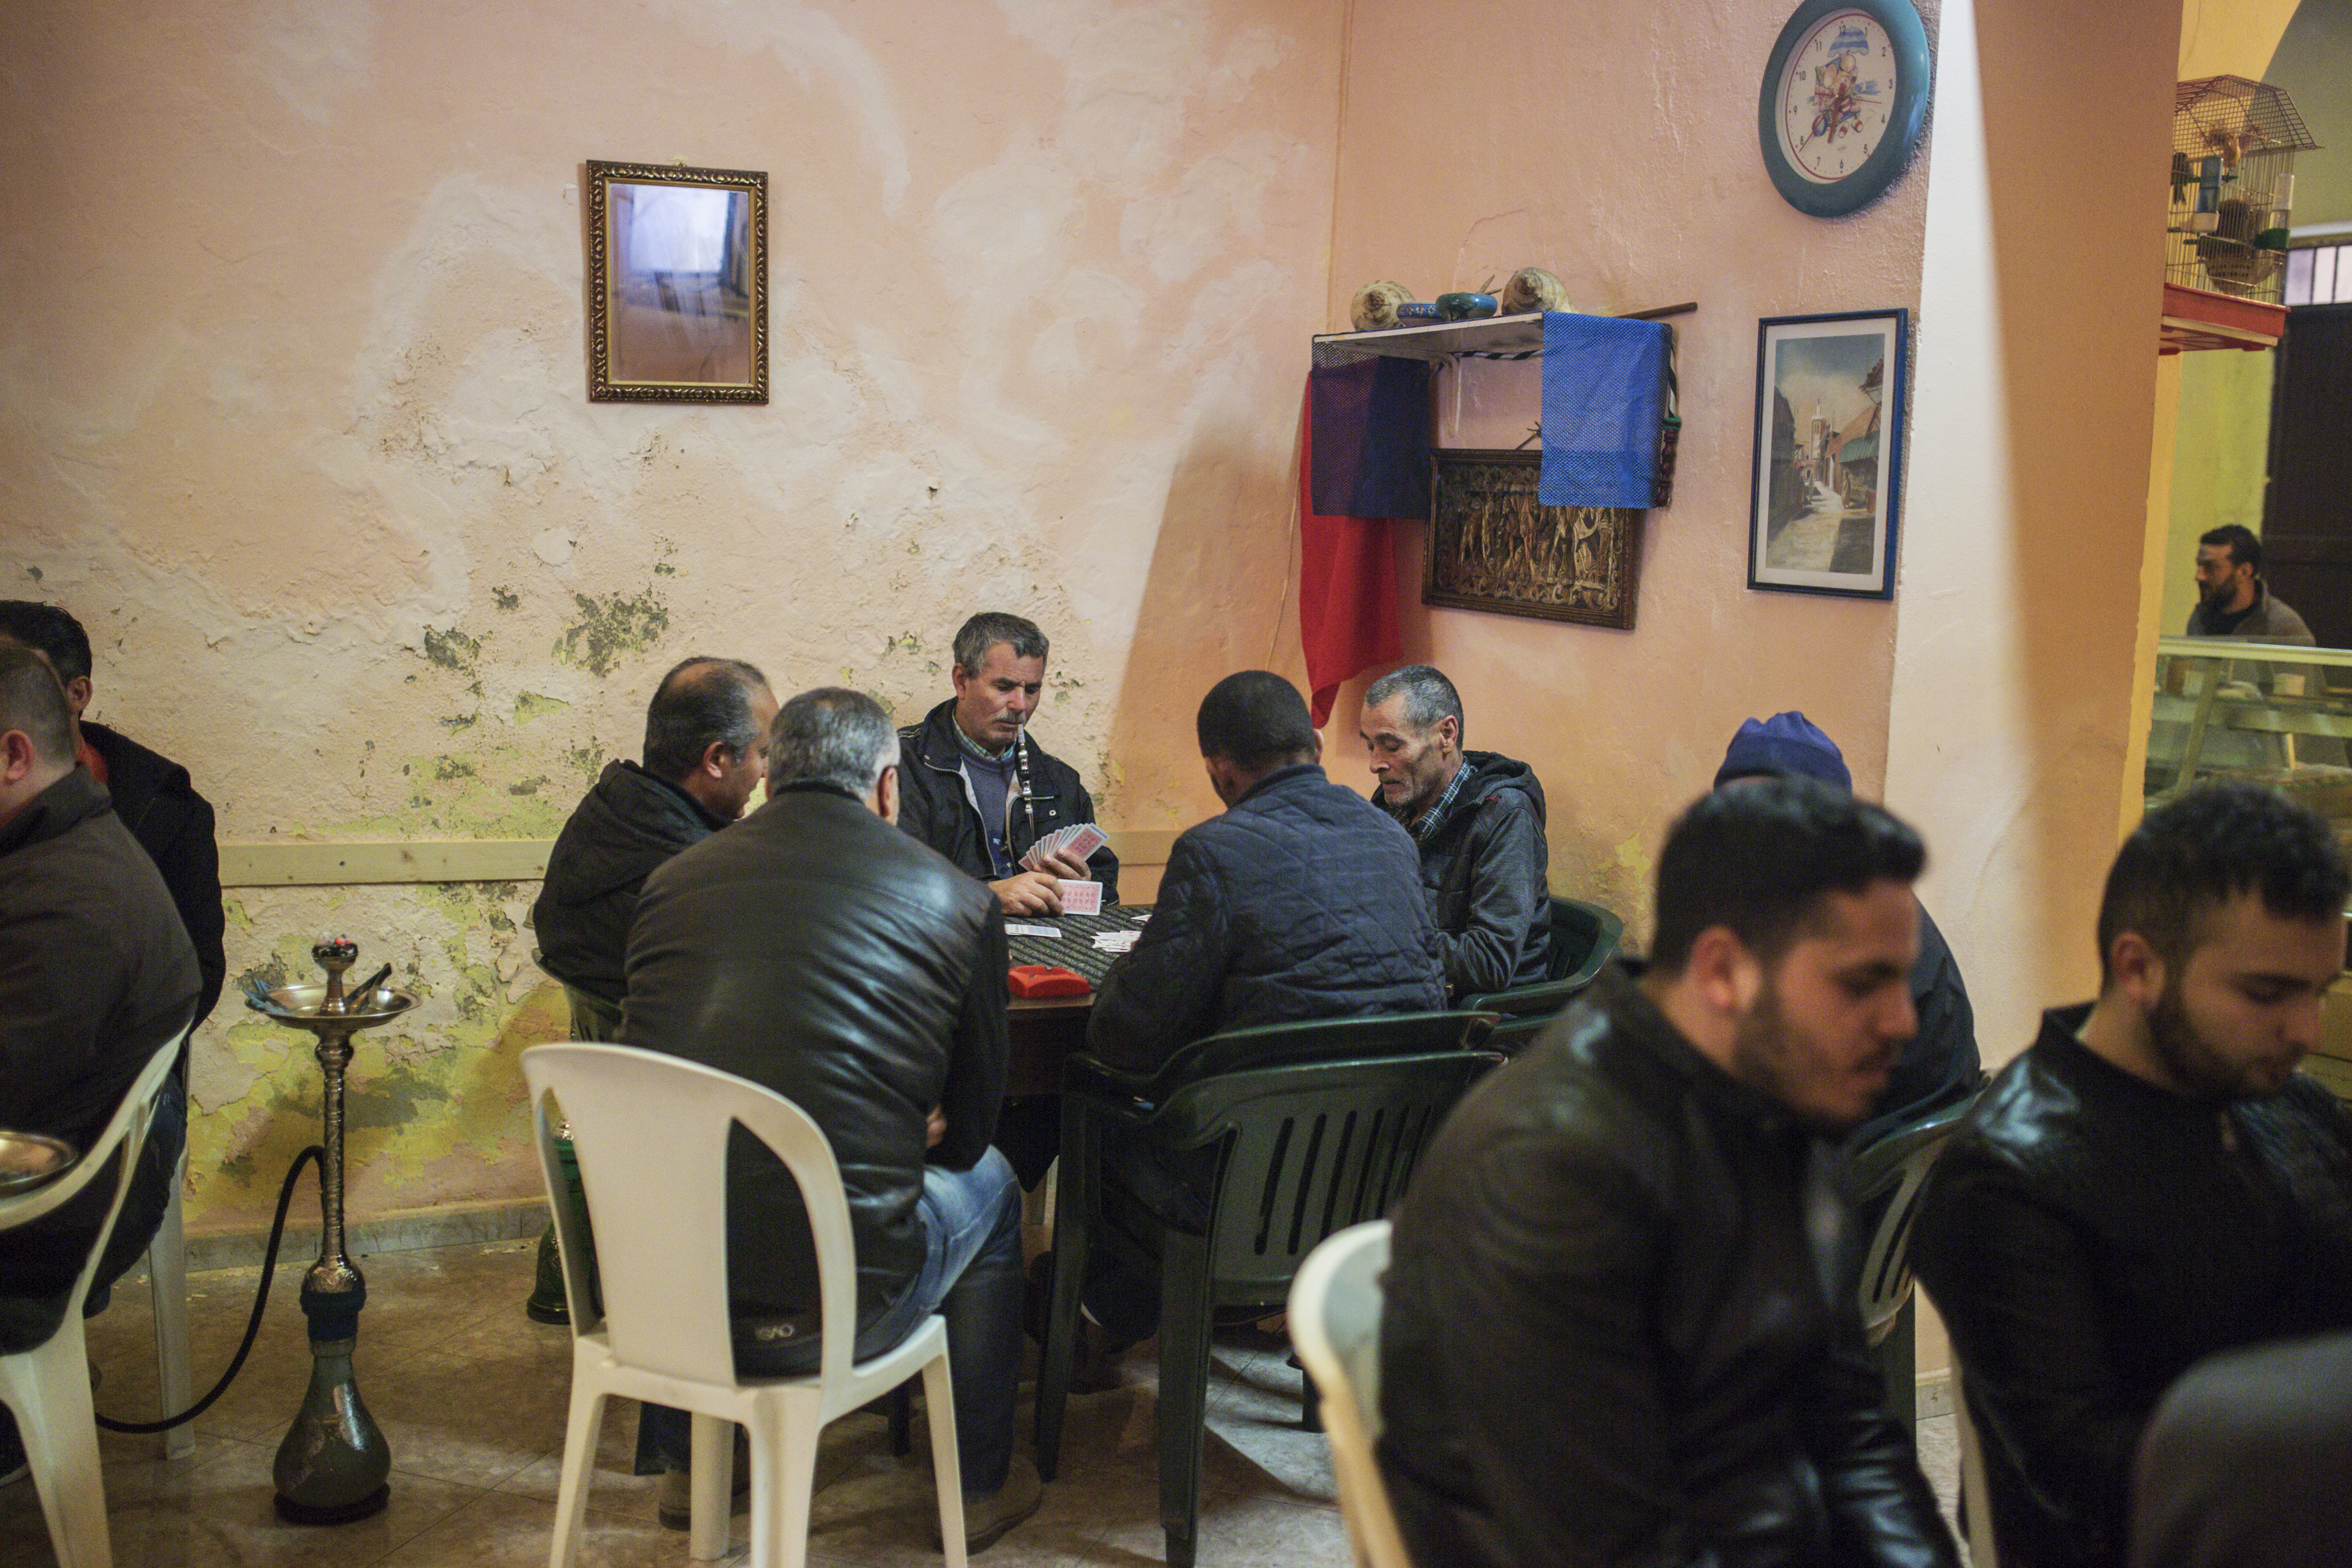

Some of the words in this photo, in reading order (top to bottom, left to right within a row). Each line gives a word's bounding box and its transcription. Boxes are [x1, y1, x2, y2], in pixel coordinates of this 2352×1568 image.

[1839, 25, 1846, 35] 12
[1864, 27, 1867, 36] 1
[1816, 41, 1822, 51] 11
[1882, 47, 1886, 56] 2
[1800, 71, 1806, 81] 10
[1889, 79, 1893, 89] 3
[1794, 106, 1797, 115] 9
[1881, 114, 1885, 124] 4
[1800, 136, 1804, 145] 8
[1864, 145, 1868, 154] 5
[1817, 157, 1821, 166] 7
[1840, 159, 1844, 169] 6
